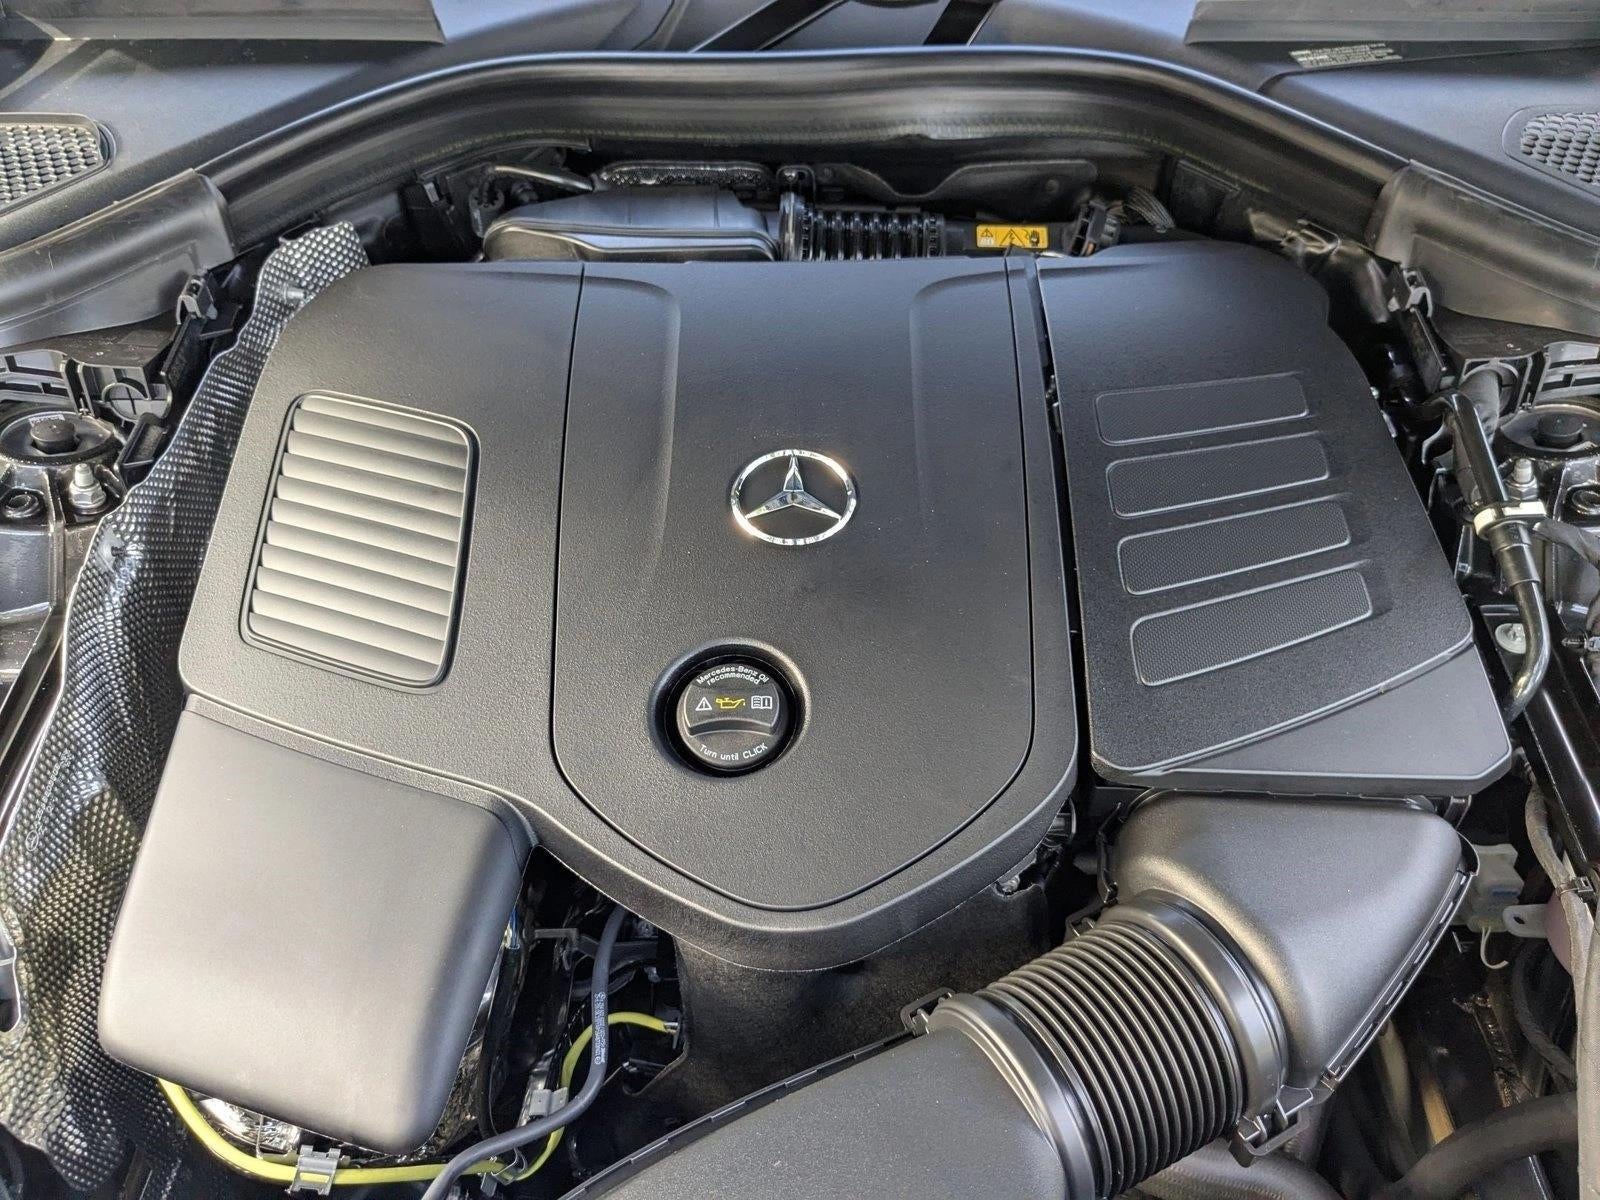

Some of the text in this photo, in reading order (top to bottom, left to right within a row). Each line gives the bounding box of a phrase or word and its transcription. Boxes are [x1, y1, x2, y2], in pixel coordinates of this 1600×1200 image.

[696, 666, 769, 684] Mercedes-Benz Oil
[706, 672, 761, 686] recommended
[700, 742, 768, 761] Turn until CLICK
